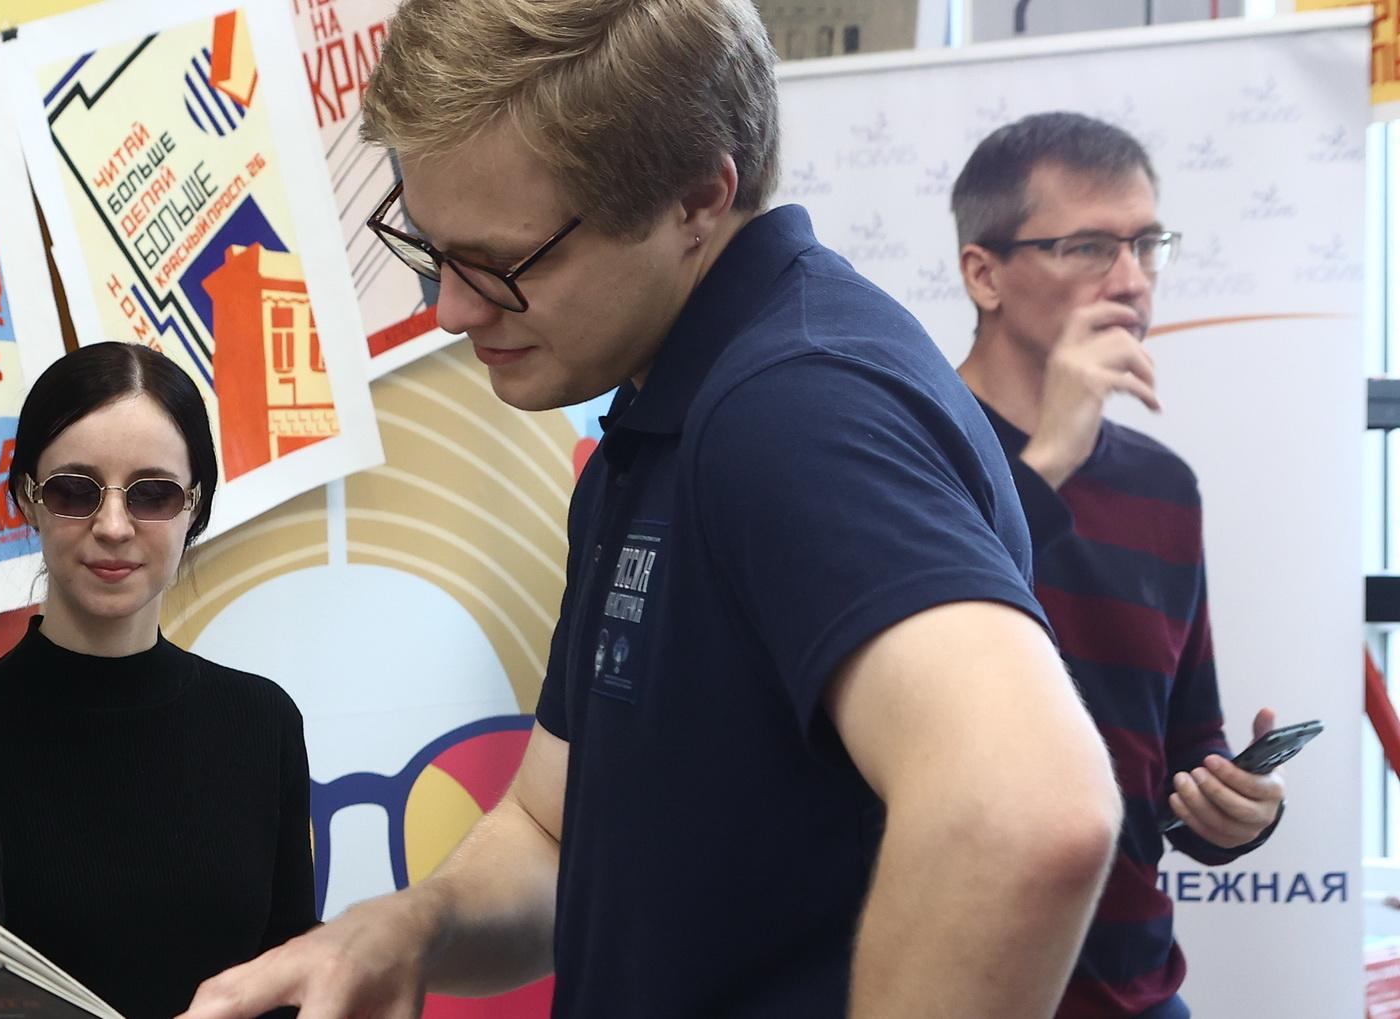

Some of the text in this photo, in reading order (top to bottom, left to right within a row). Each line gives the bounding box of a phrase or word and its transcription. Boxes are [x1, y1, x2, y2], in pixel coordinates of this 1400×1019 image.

[93, 120, 151, 191] ЧИТАЙ
[107, 130, 177, 215] БОЛЬШЕ
[120, 165, 178, 238] ДЕЛАЙ
[133, 160, 219, 270] БОЛЬШЕ
[154, 214, 212, 288] КРАСНЫЙ
